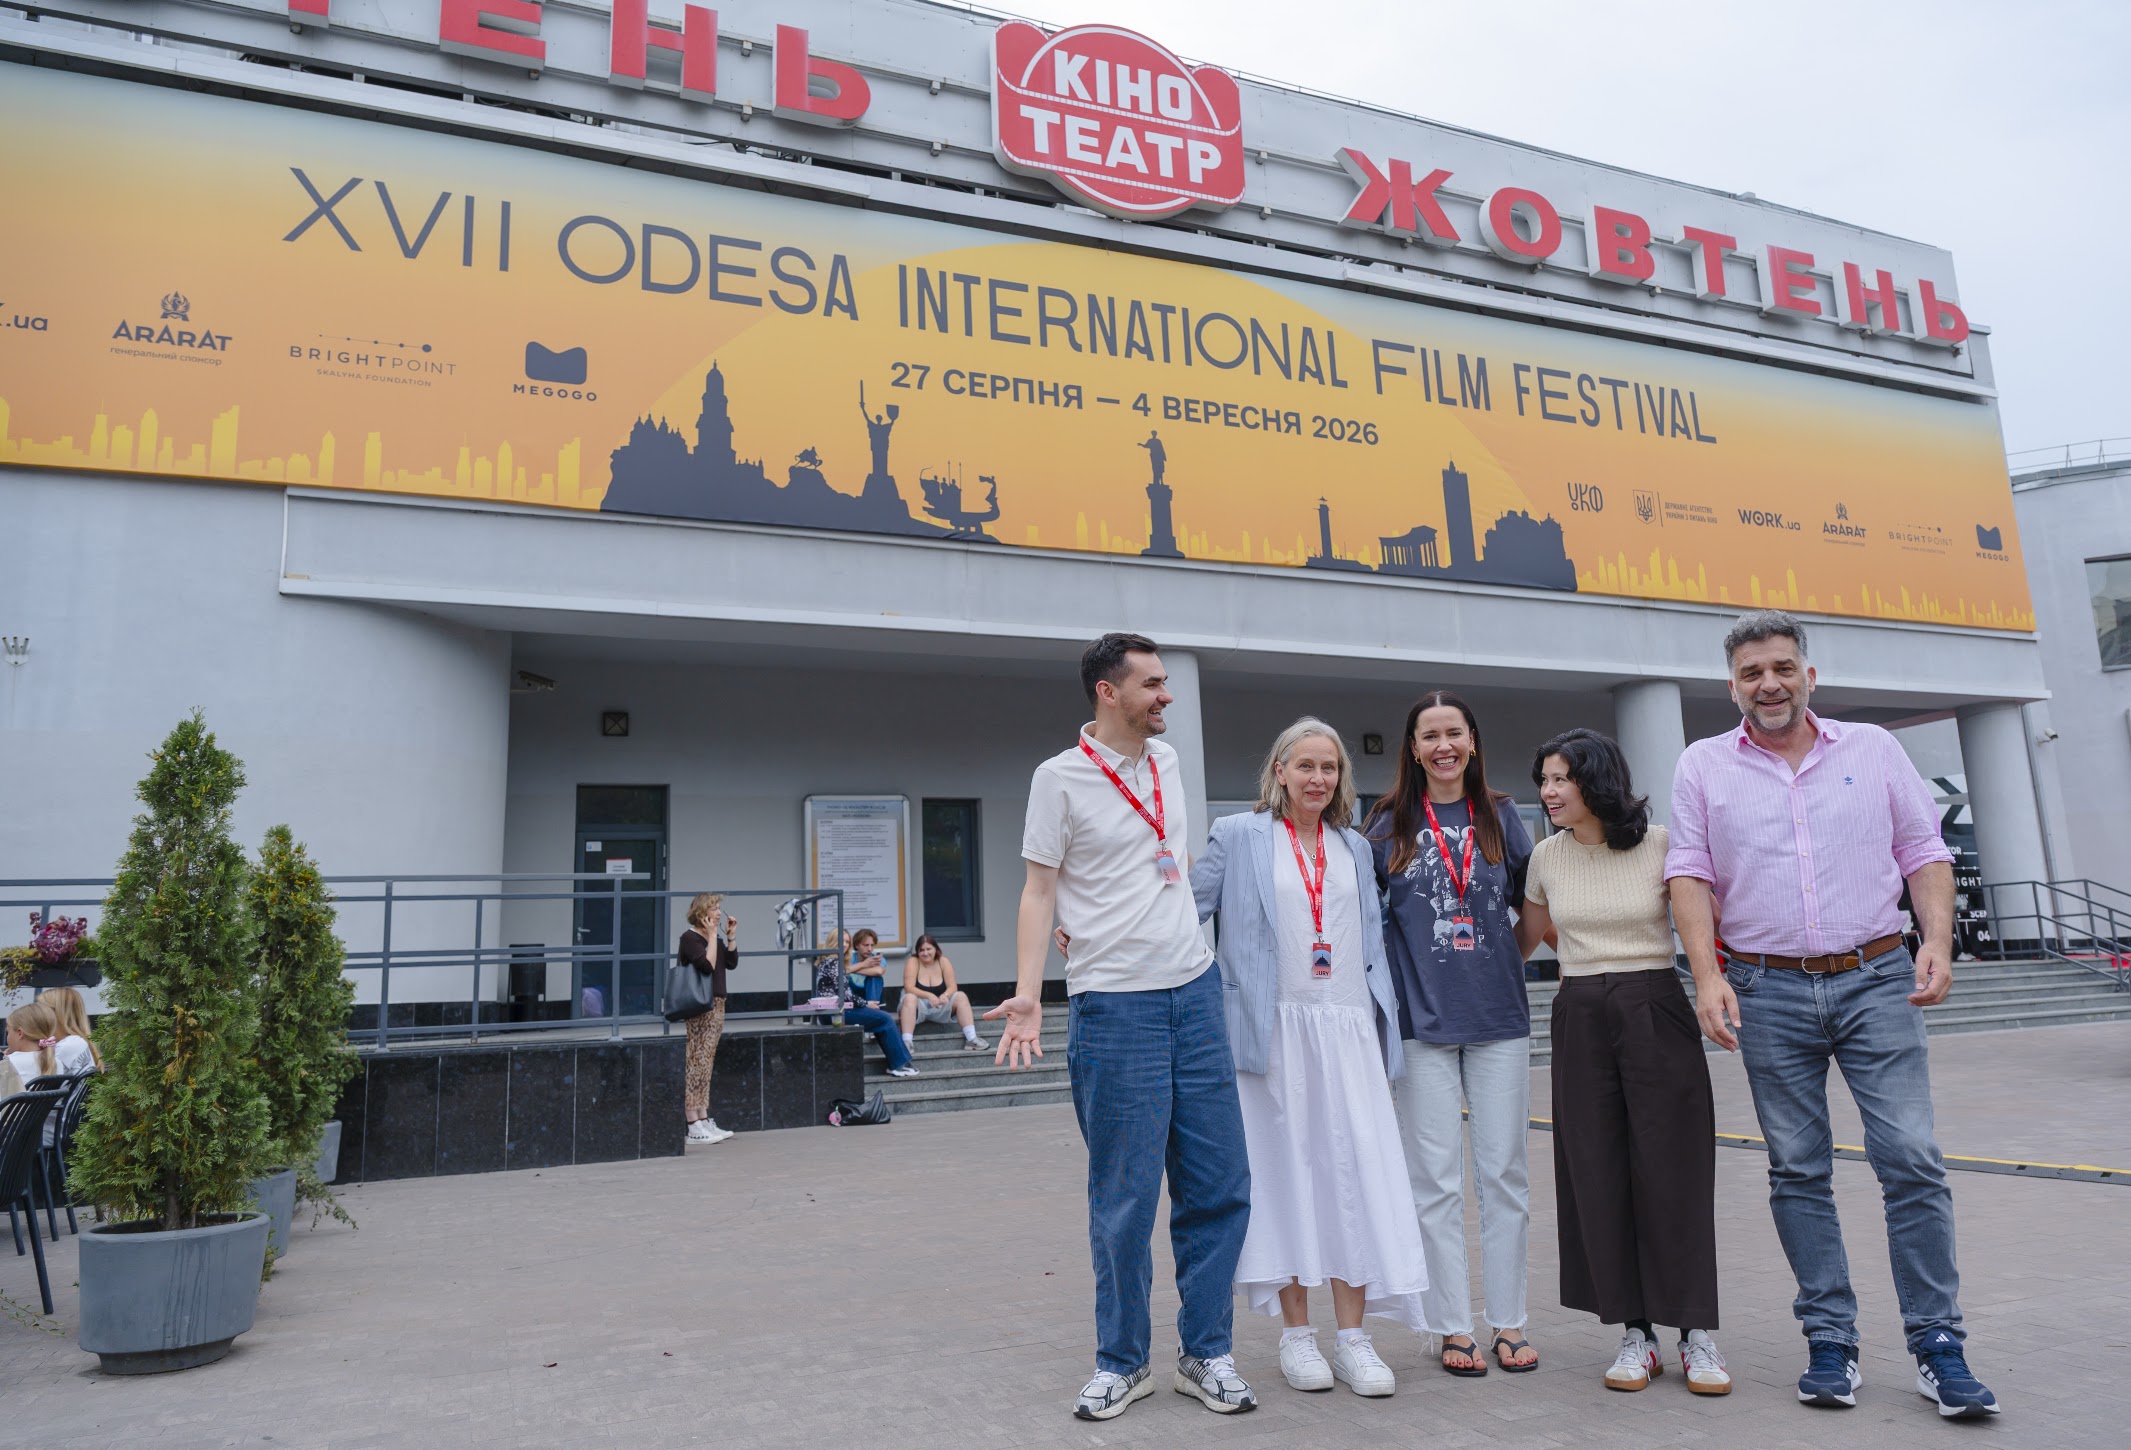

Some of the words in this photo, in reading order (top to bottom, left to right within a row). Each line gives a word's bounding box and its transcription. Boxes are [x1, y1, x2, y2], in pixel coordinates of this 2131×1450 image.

[288, 0, 872, 123] ЕНЬ
[1054, 49, 1193, 122] КІНО
[1019, 104, 1223, 184] ТЕАТР
[1337, 147, 1970, 347] ЖОВТЕНЬ
[0, 302, 48, 331] .ua
[283, 167, 511, 272] XVII
[558, 214, 859, 322] ODESA
[898, 264, 1348, 390] INTERNATIONAL
[1372, 339, 1491, 411] FILM
[1514, 363, 1717, 445] FESTIVAL
[111, 318, 233, 352] ARARAT
[110, 346, 177, 361] генеральний
[179, 352, 222, 367] спонсор
[316, 368, 362, 380] SKALYHA
[365, 373, 432, 388] FOUNDATION
[513, 383, 598, 402] MEGOGO
[891, 361, 930, 389] 27
[943, 369, 1083, 410] СЕРПНЯ
[1132, 393, 1152, 416] 4
[1163, 395, 1302, 437] ВЕРЕСНЯ
[1312, 414, 1380, 446] 2026
[1822, 520, 1867, 539] ARARAT
[1976, 551, 2010, 562] MEGOGO
